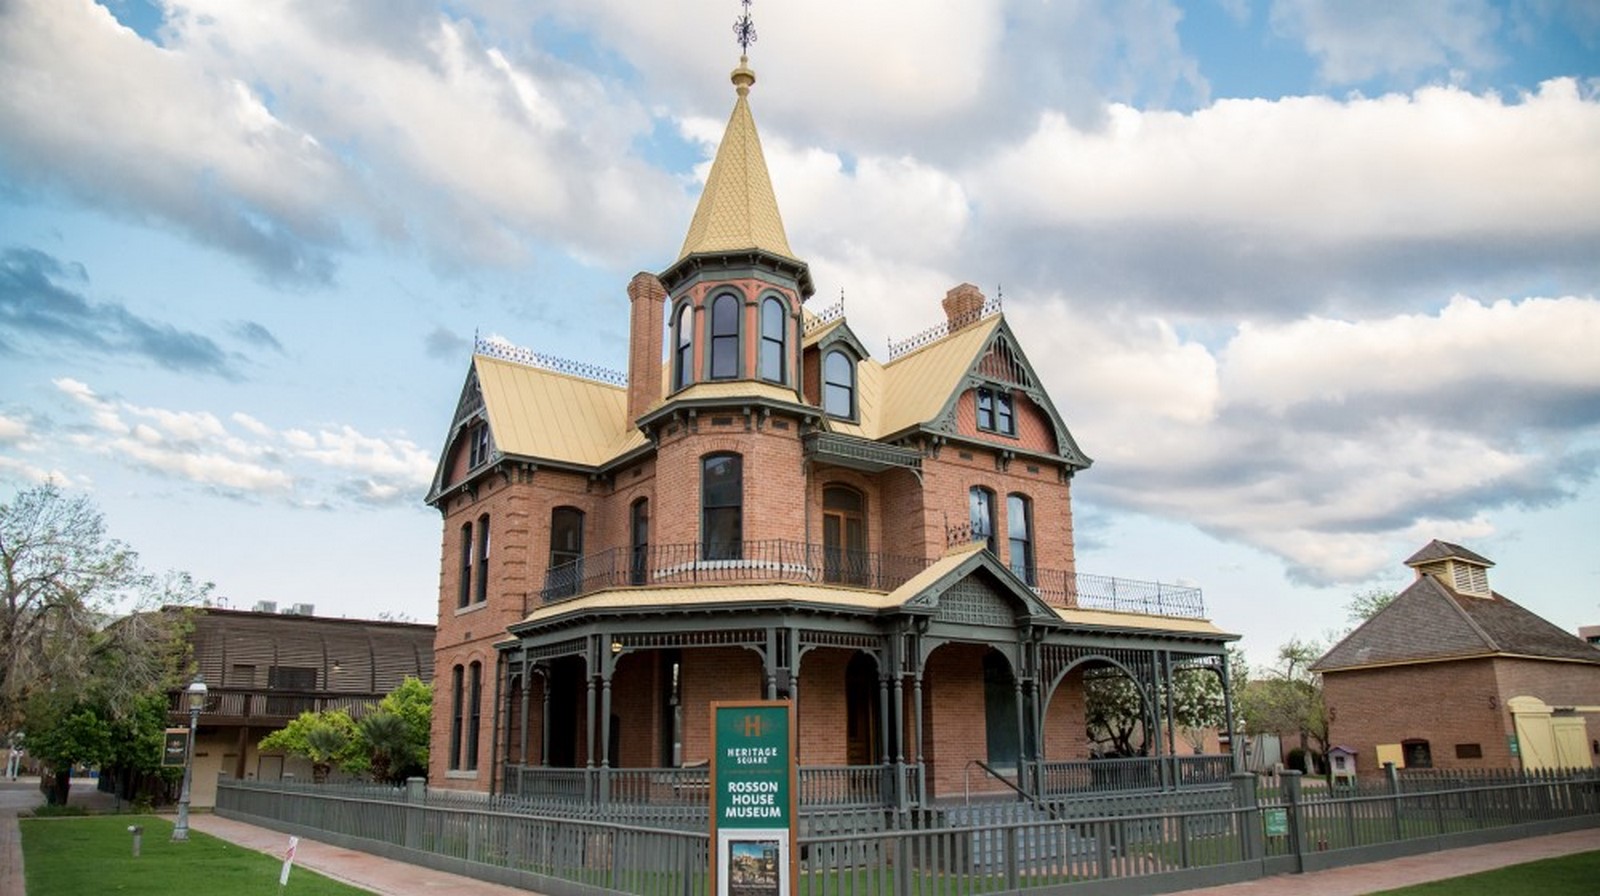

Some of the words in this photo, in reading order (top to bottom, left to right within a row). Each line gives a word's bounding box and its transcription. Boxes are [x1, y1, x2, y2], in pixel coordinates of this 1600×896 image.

[744, 715, 761, 737] H
[727, 747, 778, 757] HERITAGE
[737, 756, 768, 764] SQUARE
[728, 781, 779, 793] ROSSON
[732, 794, 775, 805] HOUSE
[725, 806, 781, 818] MUSEUM
